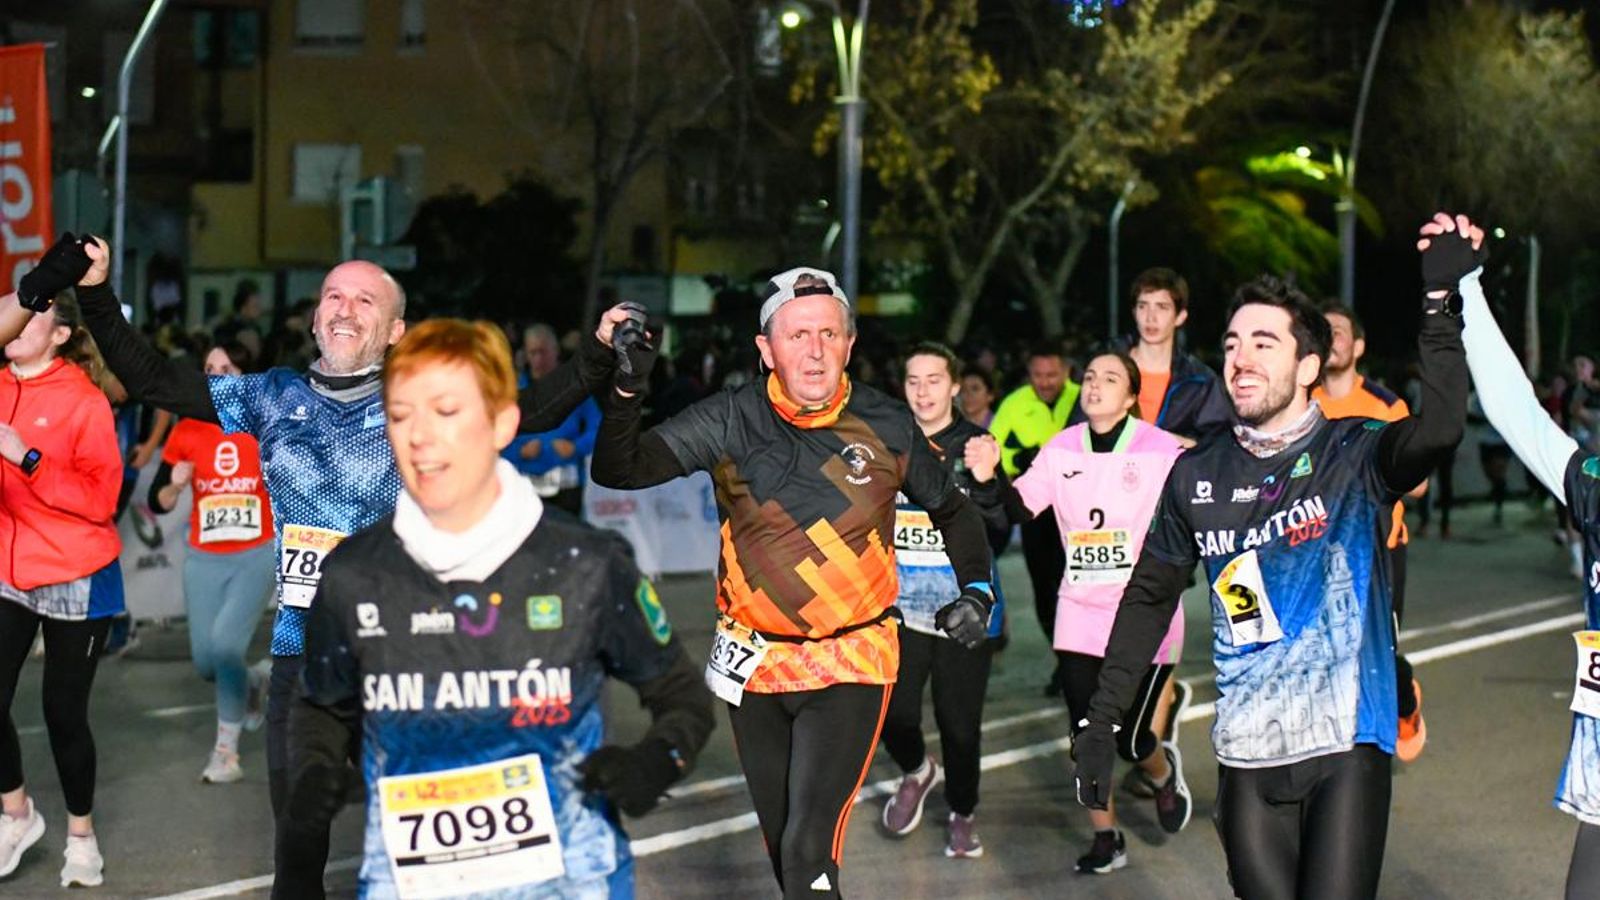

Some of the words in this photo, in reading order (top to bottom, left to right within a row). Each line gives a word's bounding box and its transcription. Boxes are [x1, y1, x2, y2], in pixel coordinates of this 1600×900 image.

[206, 507, 252, 526] 8231
[1194, 530, 1236, 557] SAN
[1243, 495, 1328, 549] ANTÓN
[896, 527, 940, 545] 455
[285, 548, 321, 577] 78
[1072, 545, 1126, 564] 4585
[364, 673, 424, 710] SAN
[434, 658, 573, 710] ANTÓN
[511, 694, 573, 728] 2025
[399, 797, 534, 851] 7098
